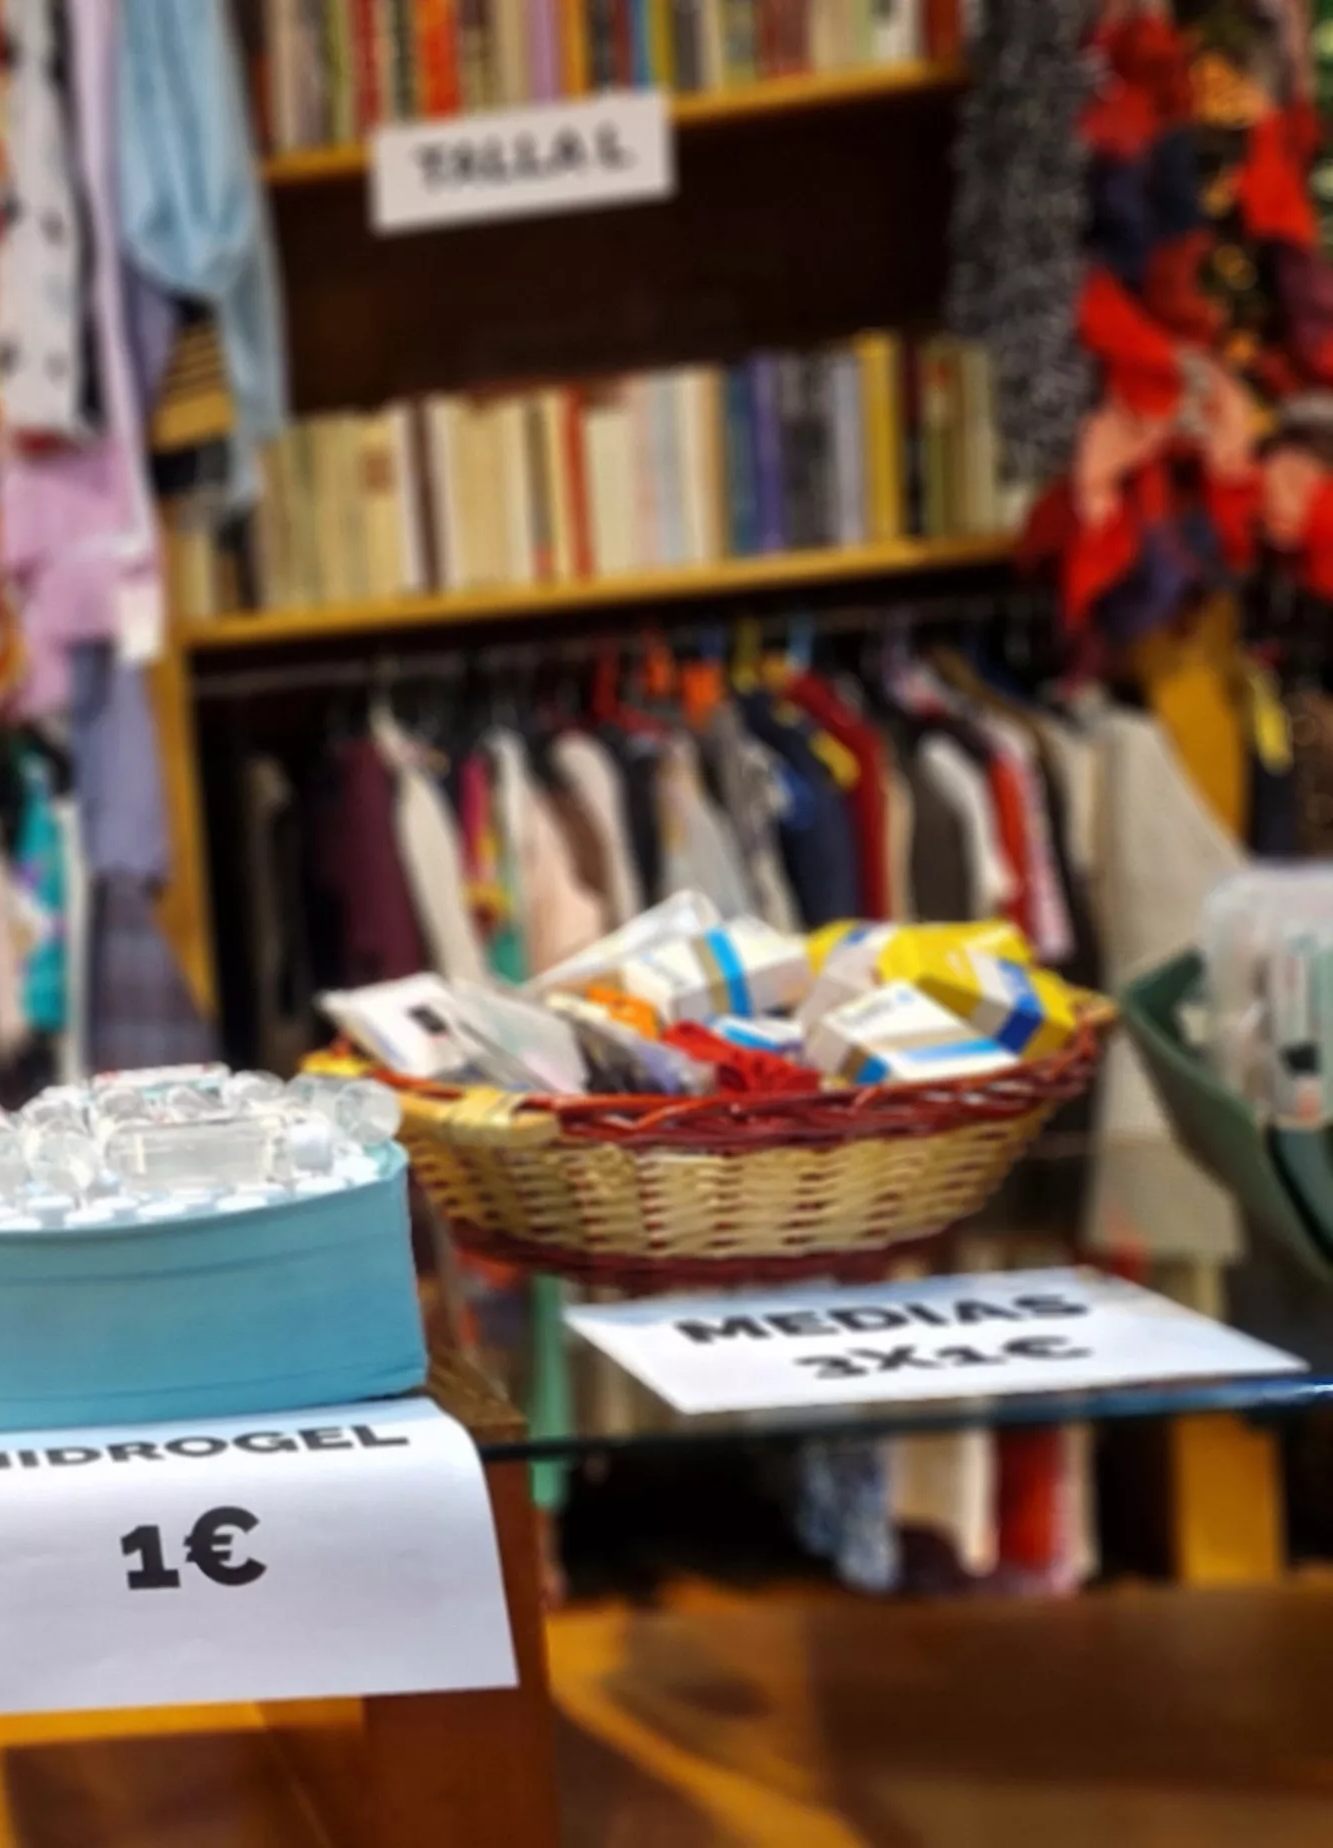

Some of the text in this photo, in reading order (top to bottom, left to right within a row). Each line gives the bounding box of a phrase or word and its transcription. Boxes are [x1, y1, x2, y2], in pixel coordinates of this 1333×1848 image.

[411, 122, 585, 196] TALLA
[674, 1294, 1089, 1343] MEDIAS
[120, 1506, 267, 1590] 1€
